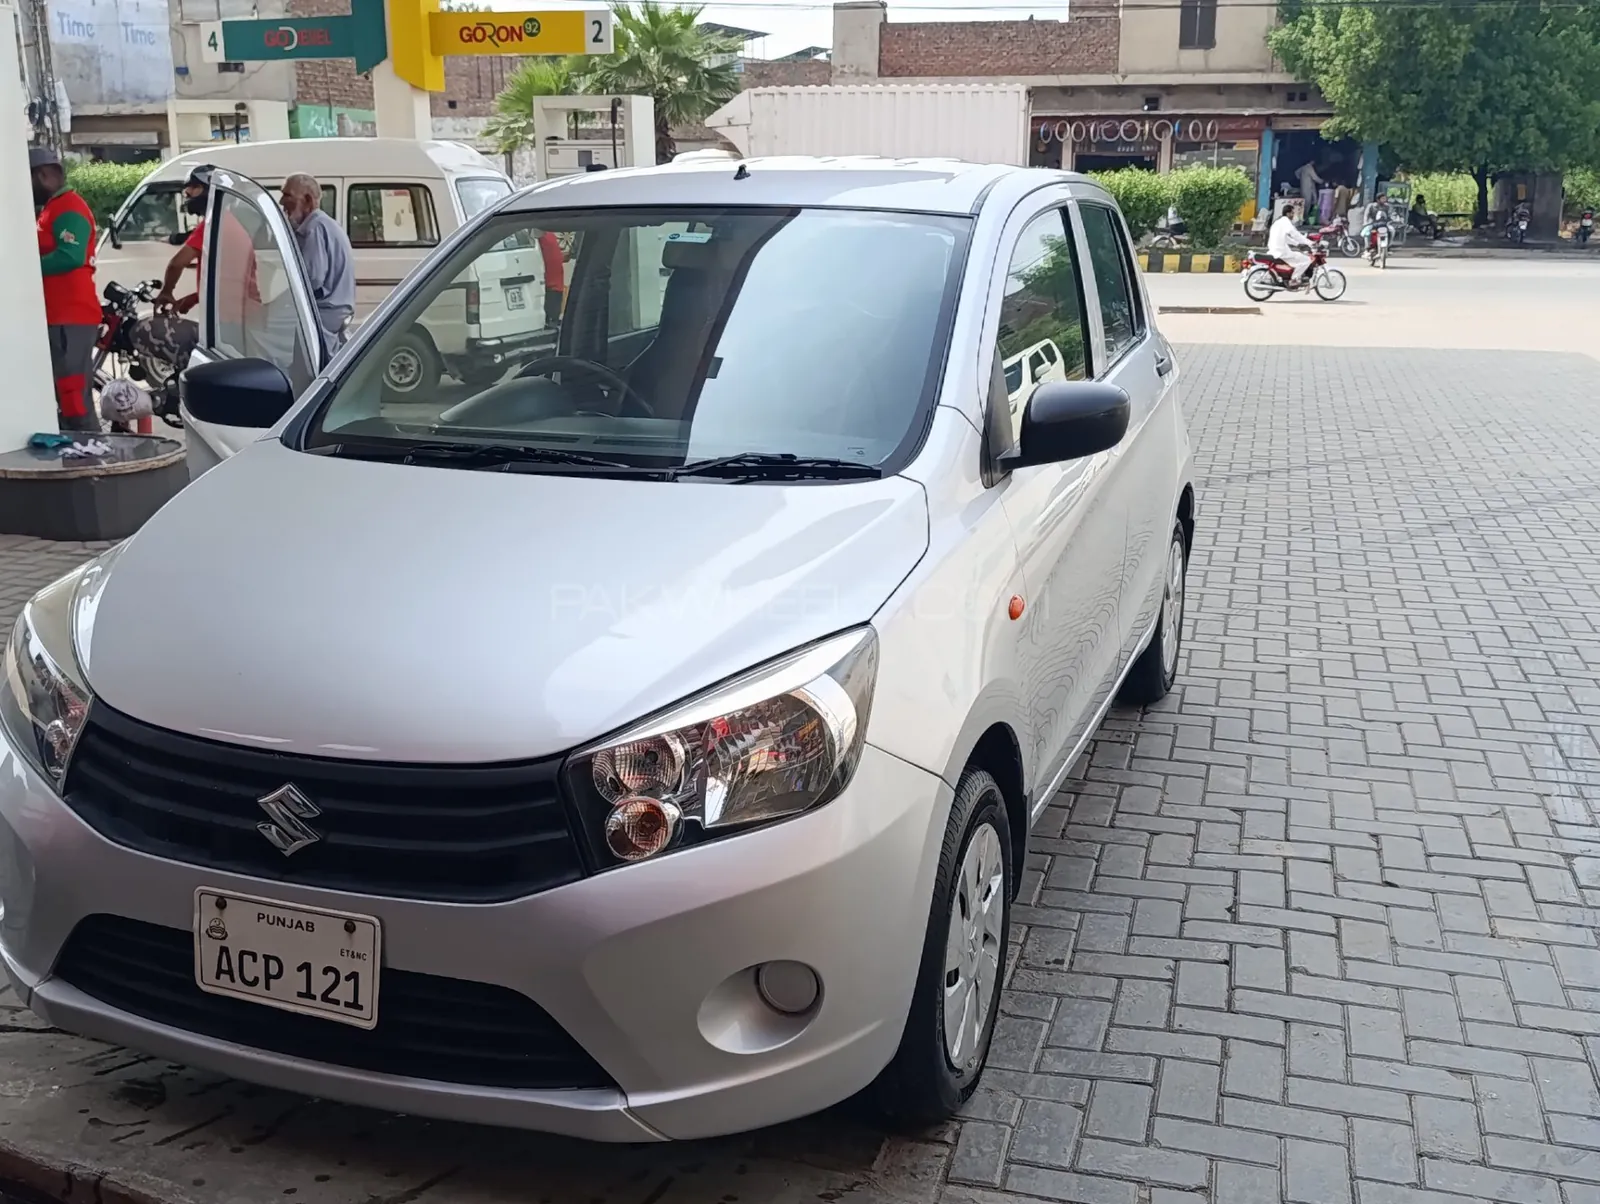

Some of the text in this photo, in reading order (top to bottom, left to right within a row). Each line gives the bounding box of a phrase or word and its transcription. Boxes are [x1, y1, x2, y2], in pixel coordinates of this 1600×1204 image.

[57, 10, 95, 38] Time
[121, 22, 156, 45] Time
[459, 22, 539, 47] GORON 92
[591, 19, 604, 43] 2
[207, 31, 219, 52] 4
[256, 912, 315, 933] PUNJAB
[340, 948, 367, 962] ET&NC
[215, 945, 364, 1011] ACP 121
